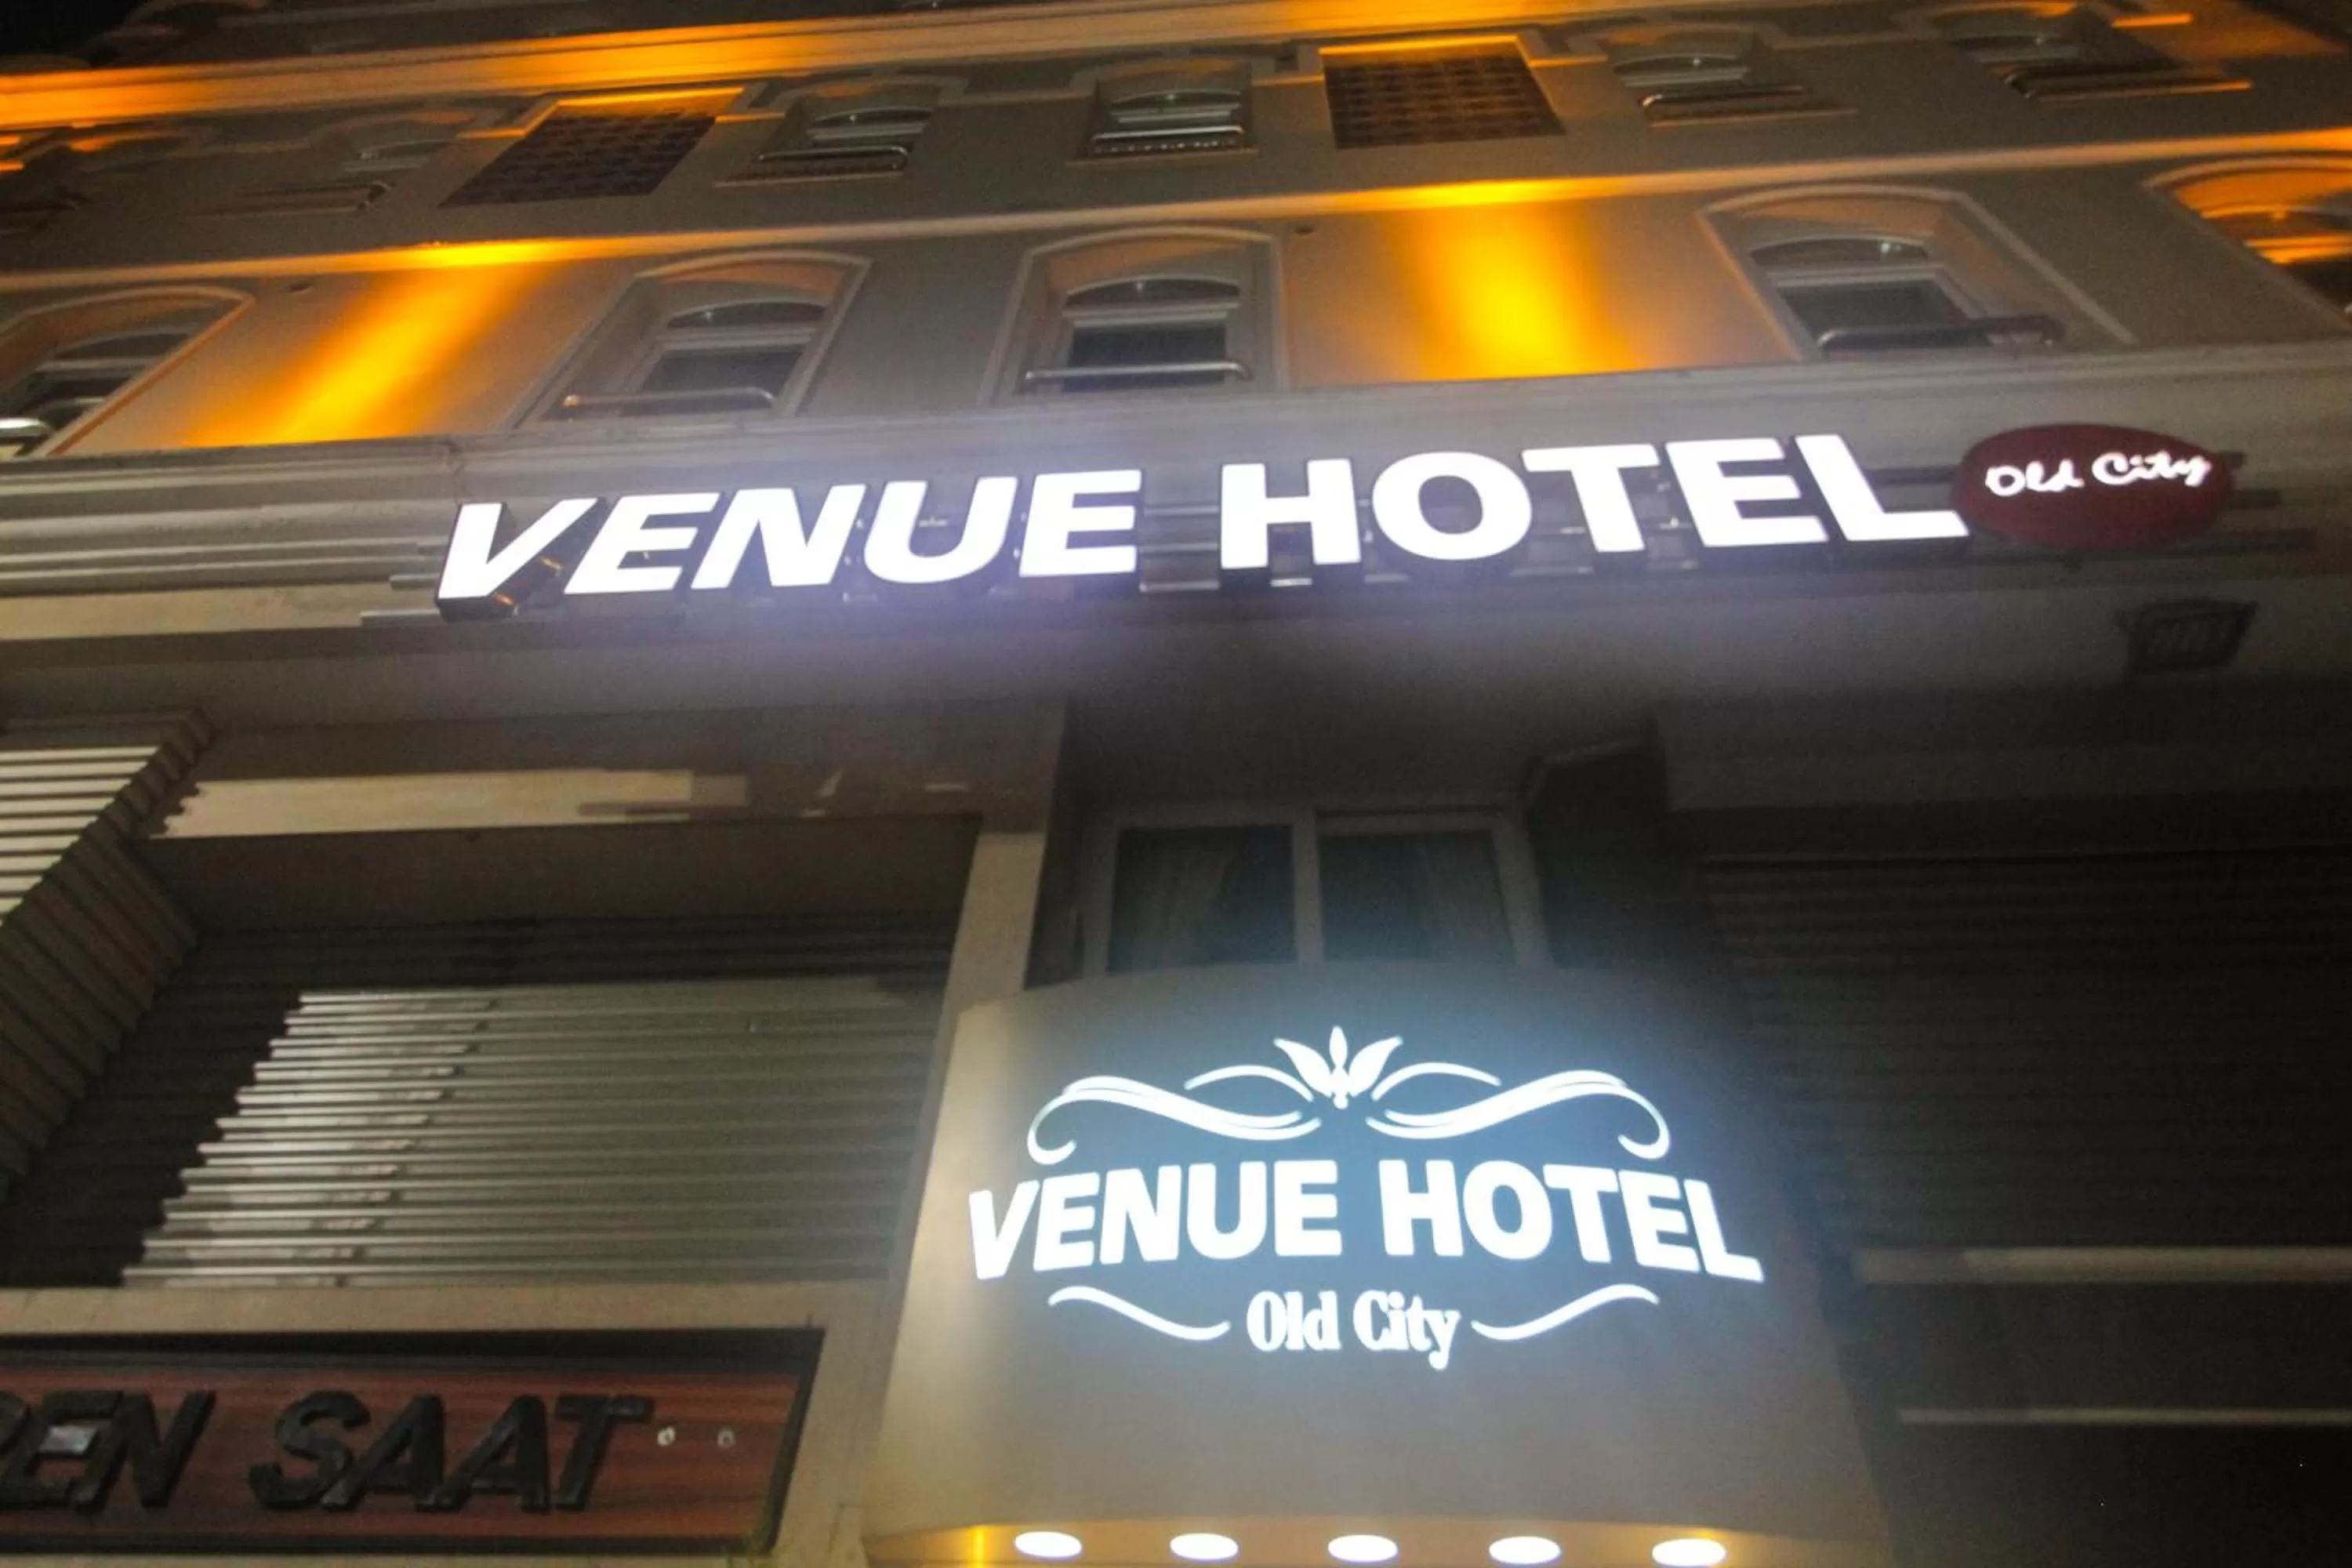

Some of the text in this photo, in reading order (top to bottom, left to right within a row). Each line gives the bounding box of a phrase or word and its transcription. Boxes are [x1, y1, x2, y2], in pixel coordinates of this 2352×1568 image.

[437, 434, 1969, 599] VENUE HOTEL
[1984, 451, 2212, 497] Old City
[967, 1159, 1764, 1282] VENUE HOTEL
[1245, 1288, 1462, 1371] Old City
[248, 1390, 654, 1514] SAAT
